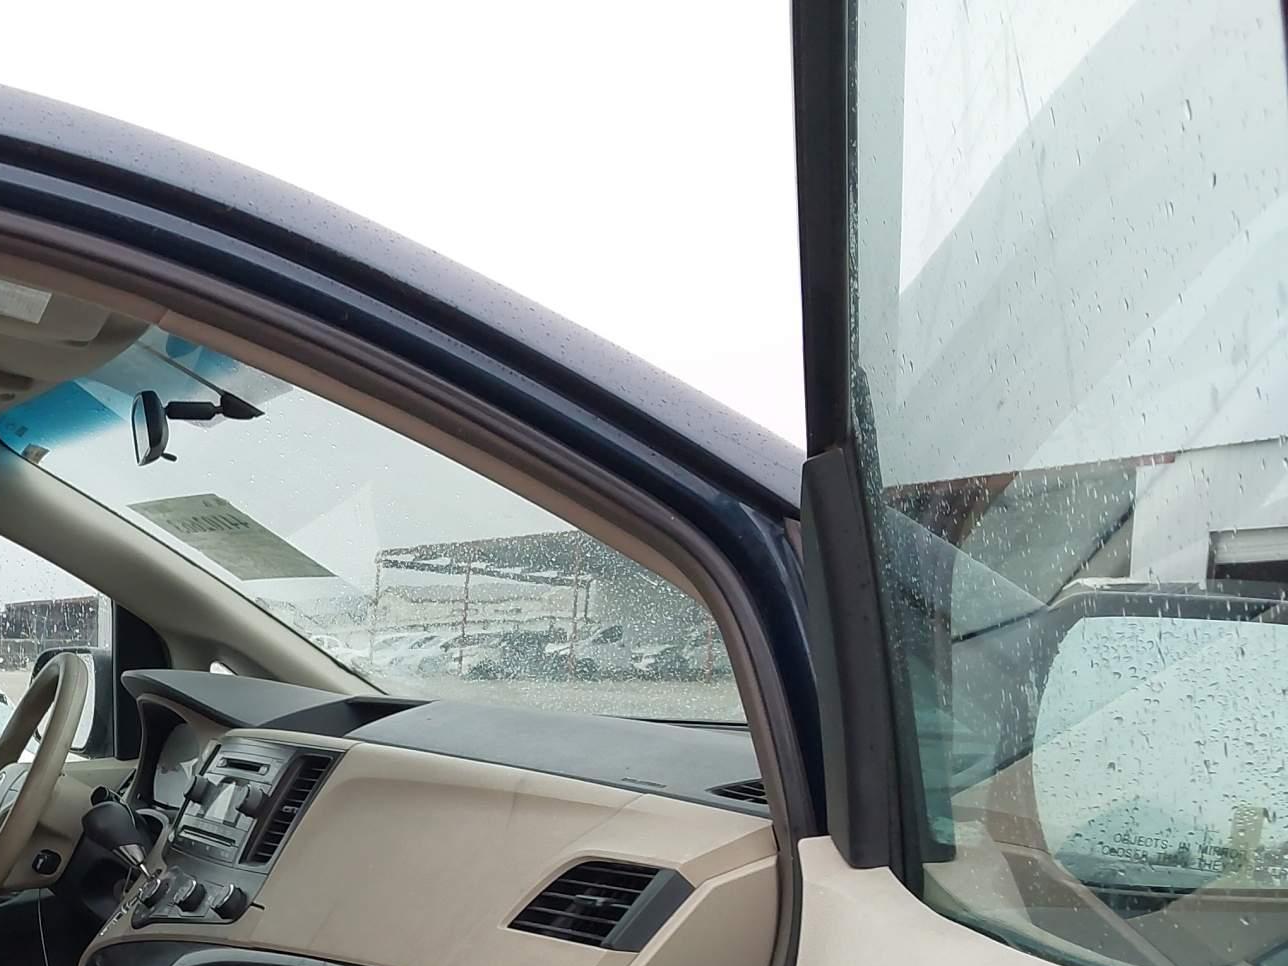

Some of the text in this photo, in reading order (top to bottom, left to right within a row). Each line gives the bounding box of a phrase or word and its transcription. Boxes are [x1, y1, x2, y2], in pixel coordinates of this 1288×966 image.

[1113, 832, 1169, 850] OBJECTS
[1178, 841, 1191, 852] IN
[1101, 845, 1149, 863] CLOSER
